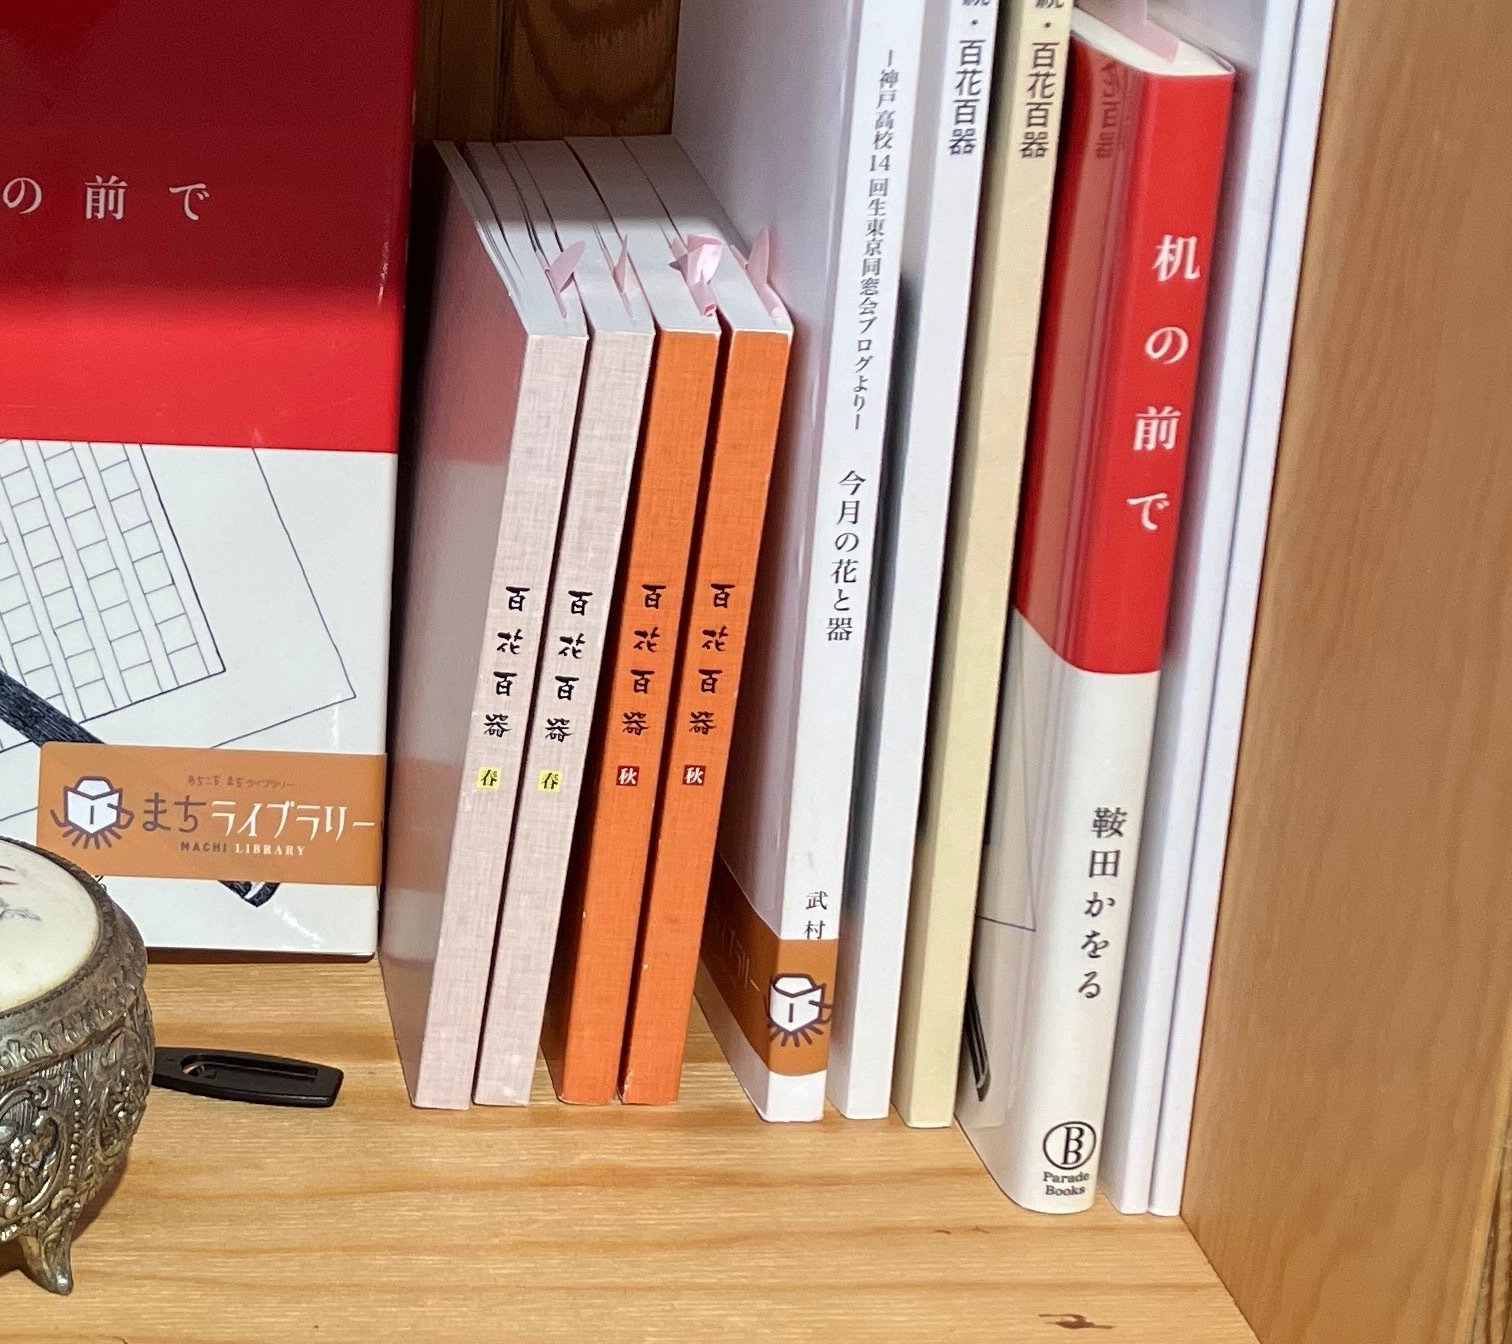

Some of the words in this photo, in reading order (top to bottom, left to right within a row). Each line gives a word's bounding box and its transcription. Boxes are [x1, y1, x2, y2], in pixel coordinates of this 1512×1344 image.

[1126, 233, 1201, 531] 机の前で
[825, 470, 867, 642] 今月の花と器
[484, 586, 531, 738] 百花百器
[545, 590, 593, 742] 百花百器
[622, 584, 667, 736] 百花百器
[689, 583, 736, 736] 百花百器
[141, 791, 375, 841] まちライブラリー
[180, 841, 227, 853] MACHI
[235, 842, 306, 856] LIBRARY
[618, 766, 639, 786] 秋
[683, 766, 705, 786] 秋
[1078, 807, 1128, 999] 鞍田かをる
[1045, 1184, 1086, 1196] Books
